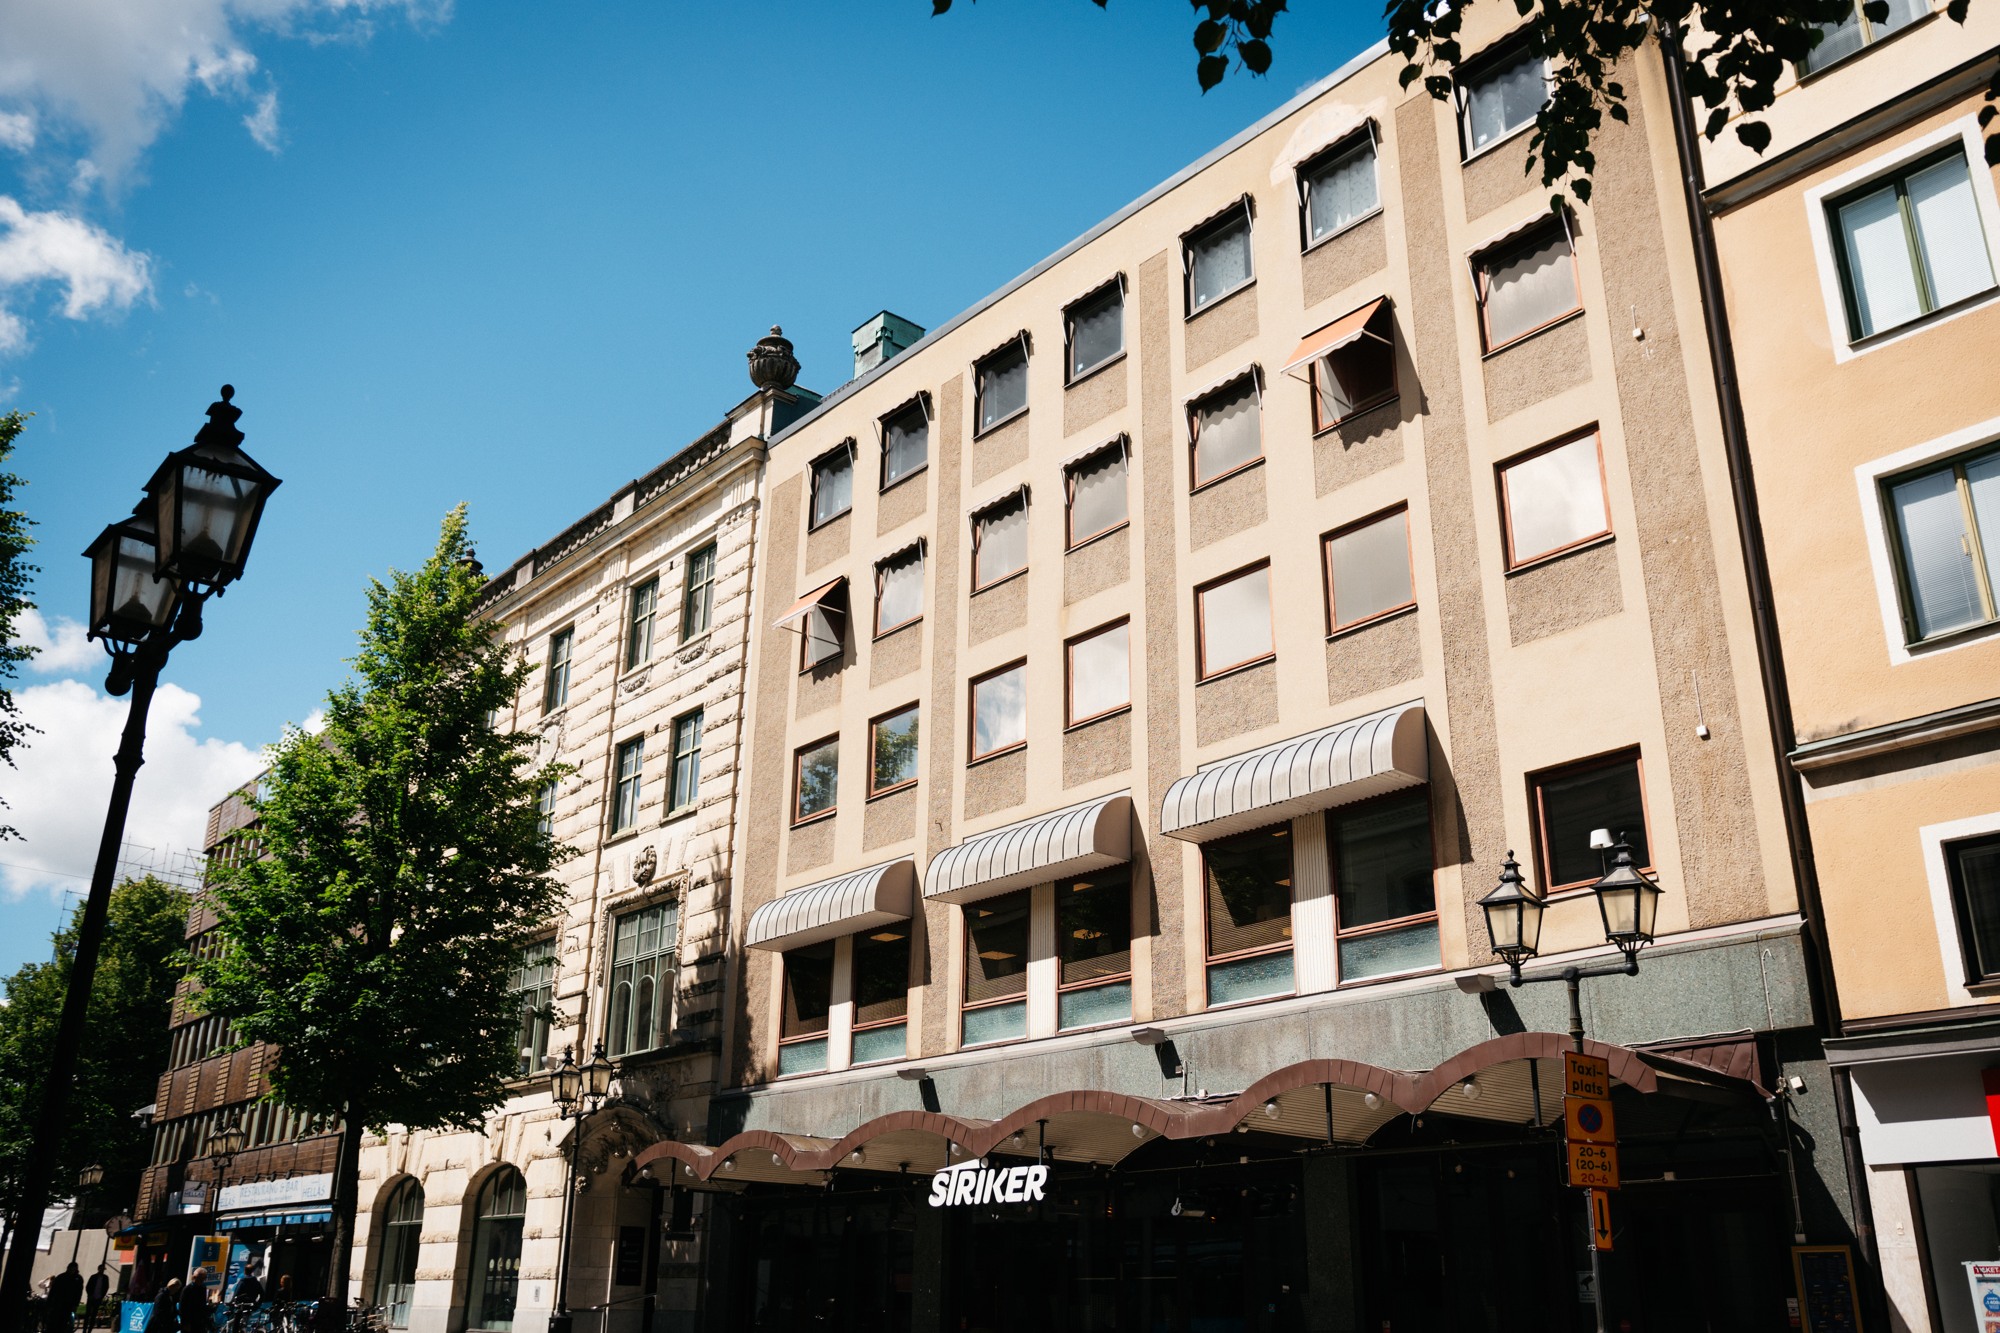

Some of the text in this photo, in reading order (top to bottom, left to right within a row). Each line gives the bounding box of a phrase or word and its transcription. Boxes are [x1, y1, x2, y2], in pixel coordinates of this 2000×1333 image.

[650, 510, 700, 558] BANK
[1571, 1060, 1603, 1077] Taxi-
[1572, 1079, 1604, 1096] plats
[1579, 1146, 1606, 1158] 20-6
[1576, 1160, 1611, 1172] (20-6)
[928, 1158, 1050, 1207] STRIKER
[1581, 1173, 1608, 1184] 20-6
[240, 1183, 278, 1198] RESTAURANG
[286, 1180, 299, 1192] BAR
[303, 1185, 326, 1198] HELLAS
[219, 1198, 236, 1208] ELLAS
